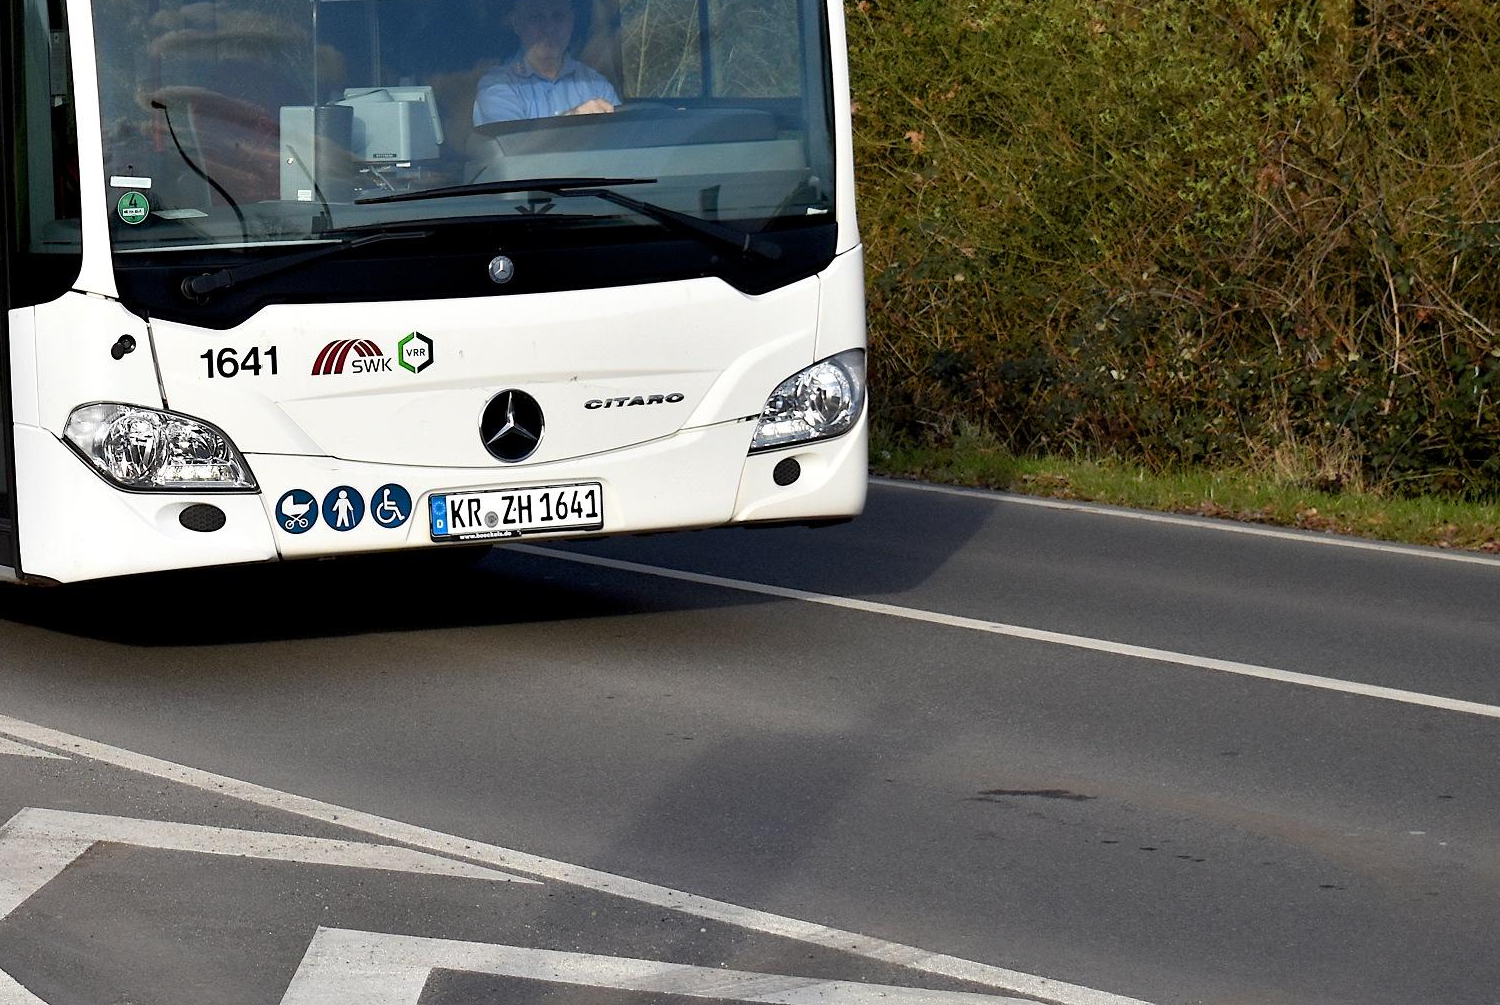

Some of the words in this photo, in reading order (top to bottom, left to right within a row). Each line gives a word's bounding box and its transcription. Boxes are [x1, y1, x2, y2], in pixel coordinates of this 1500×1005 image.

[129, 193, 138, 208] 4
[405, 348, 426, 357] VRR
[200, 345, 278, 378] 1641
[351, 357, 393, 374] SWK
[584, 392, 685, 409] CITARO
[450, 498, 482, 528] KR
[501, 494, 533, 524] ZH
[540, 489, 598, 522] 1641
[436, 519, 444, 529] D
